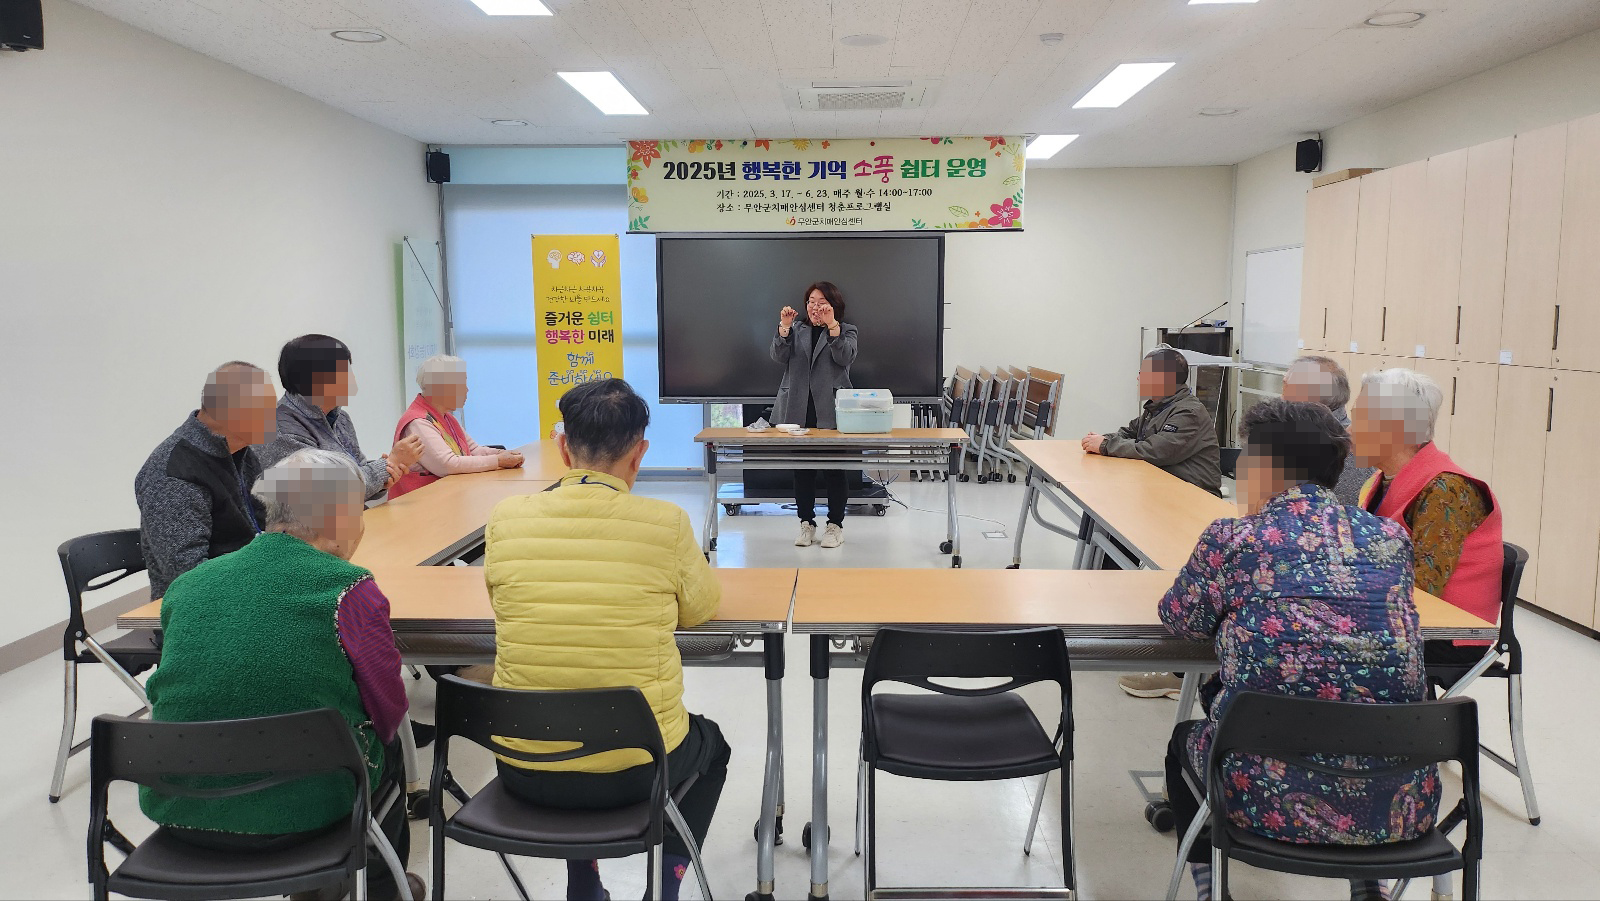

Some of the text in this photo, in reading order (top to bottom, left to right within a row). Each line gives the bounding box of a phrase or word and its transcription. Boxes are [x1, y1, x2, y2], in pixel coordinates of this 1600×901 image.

[663, 155, 986, 183] 2025년 행복한 기억 소풍 쉼터 운영
[716, 189, 735, 200] 기간
[743, 189, 767, 199] 2025.
[769, 189, 778, 199] 3.
[781, 189, 794, 199] 17.
[805, 189, 814, 199] 6.
[816, 189, 830, 199] 23.
[833, 188, 851, 199] 매주
[716, 202, 734, 213] 장소
[743, 202, 825, 213] 무안군치매안심센터
[828, 201, 891, 212] 청춘프로그램실
[797, 217, 863, 226] 무안군치매안심센터
[544, 310, 613, 326] 즐거운 쉼터
[544, 328, 614, 344] 행복한 미래
[566, 350, 595, 368] 함께
